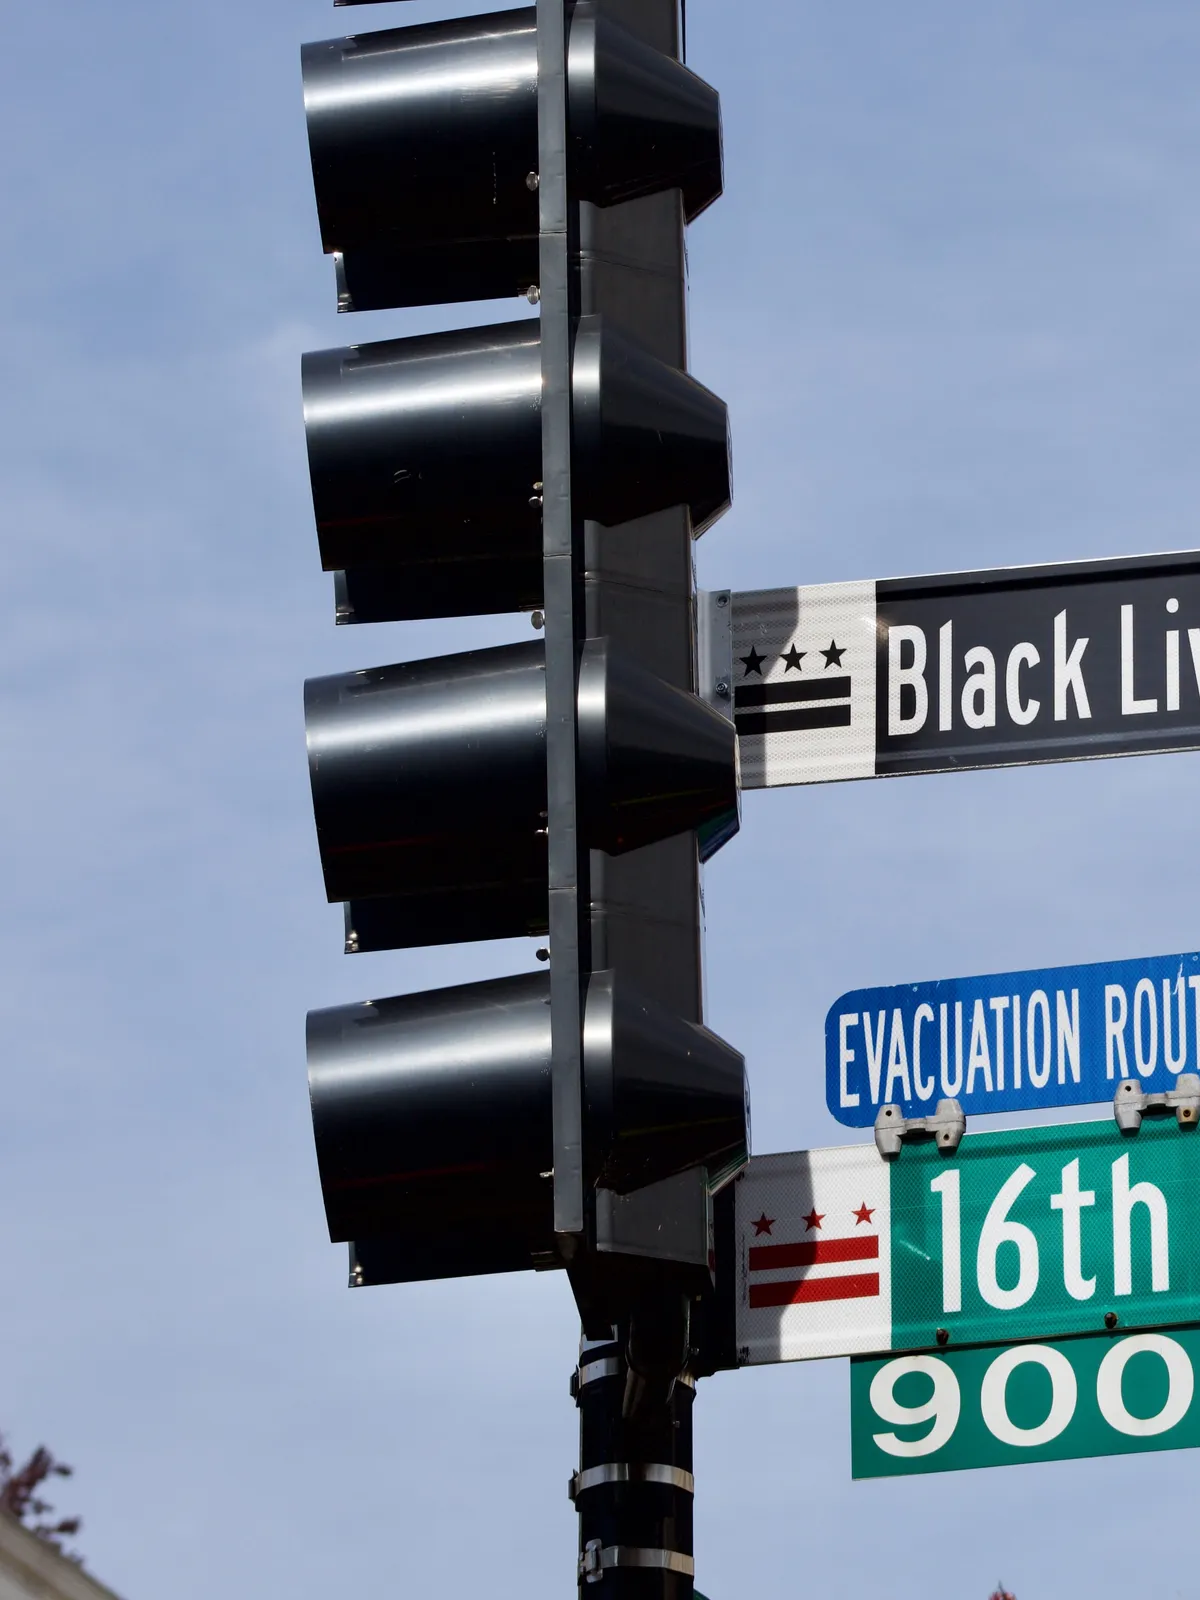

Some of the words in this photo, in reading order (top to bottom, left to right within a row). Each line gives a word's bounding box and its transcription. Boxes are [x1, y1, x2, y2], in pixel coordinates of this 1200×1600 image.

[888, 609, 1092, 736] Black
[839, 988, 1080, 1108] EVACUATION
[930, 1152, 1170, 1313] 16th
[869, 1333, 1194, 1457] 900
